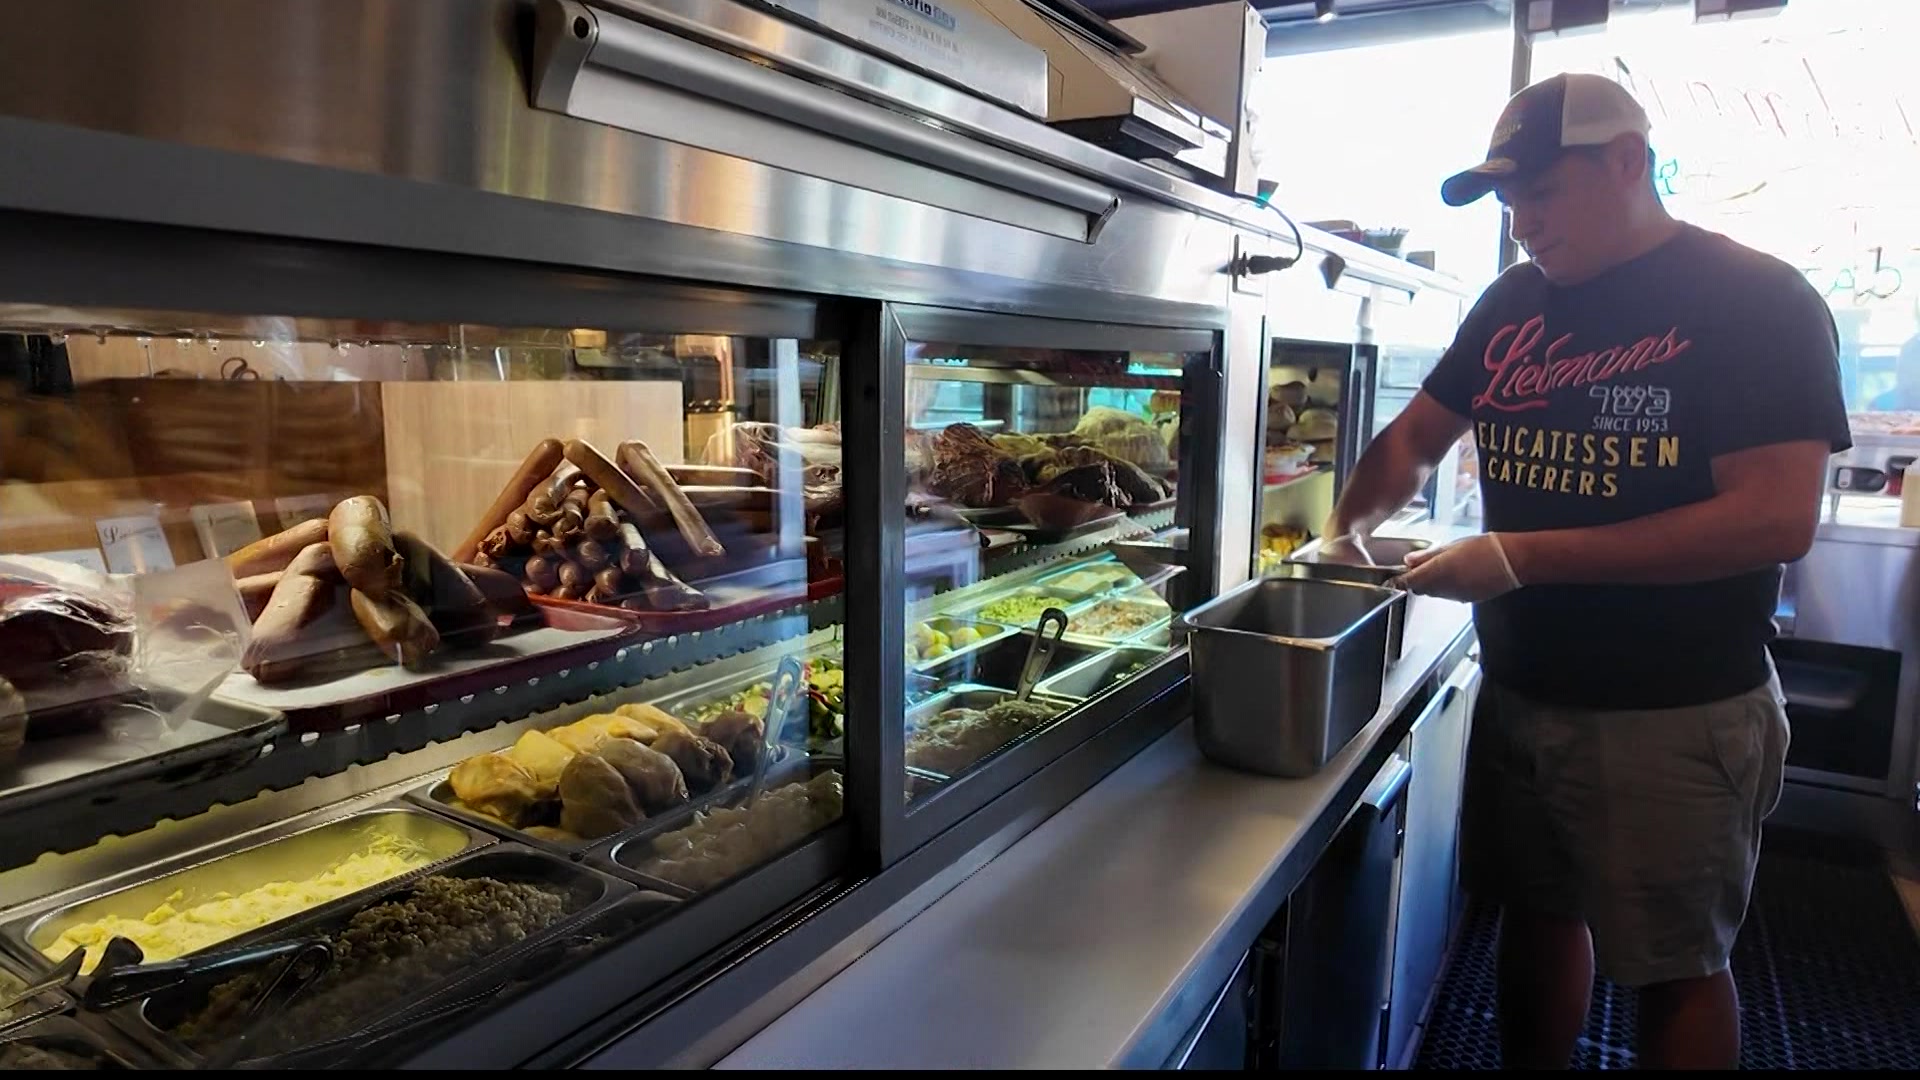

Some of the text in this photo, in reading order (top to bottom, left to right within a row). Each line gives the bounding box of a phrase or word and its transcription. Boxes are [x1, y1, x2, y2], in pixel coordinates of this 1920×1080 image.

[1472, 314, 1692, 412] Liebmans
[1478, 421, 1679, 467] ELICATESSEN
[1591, 415, 1668, 433] SINCE 1953
[1487, 456, 1618, 498] CATERERS
